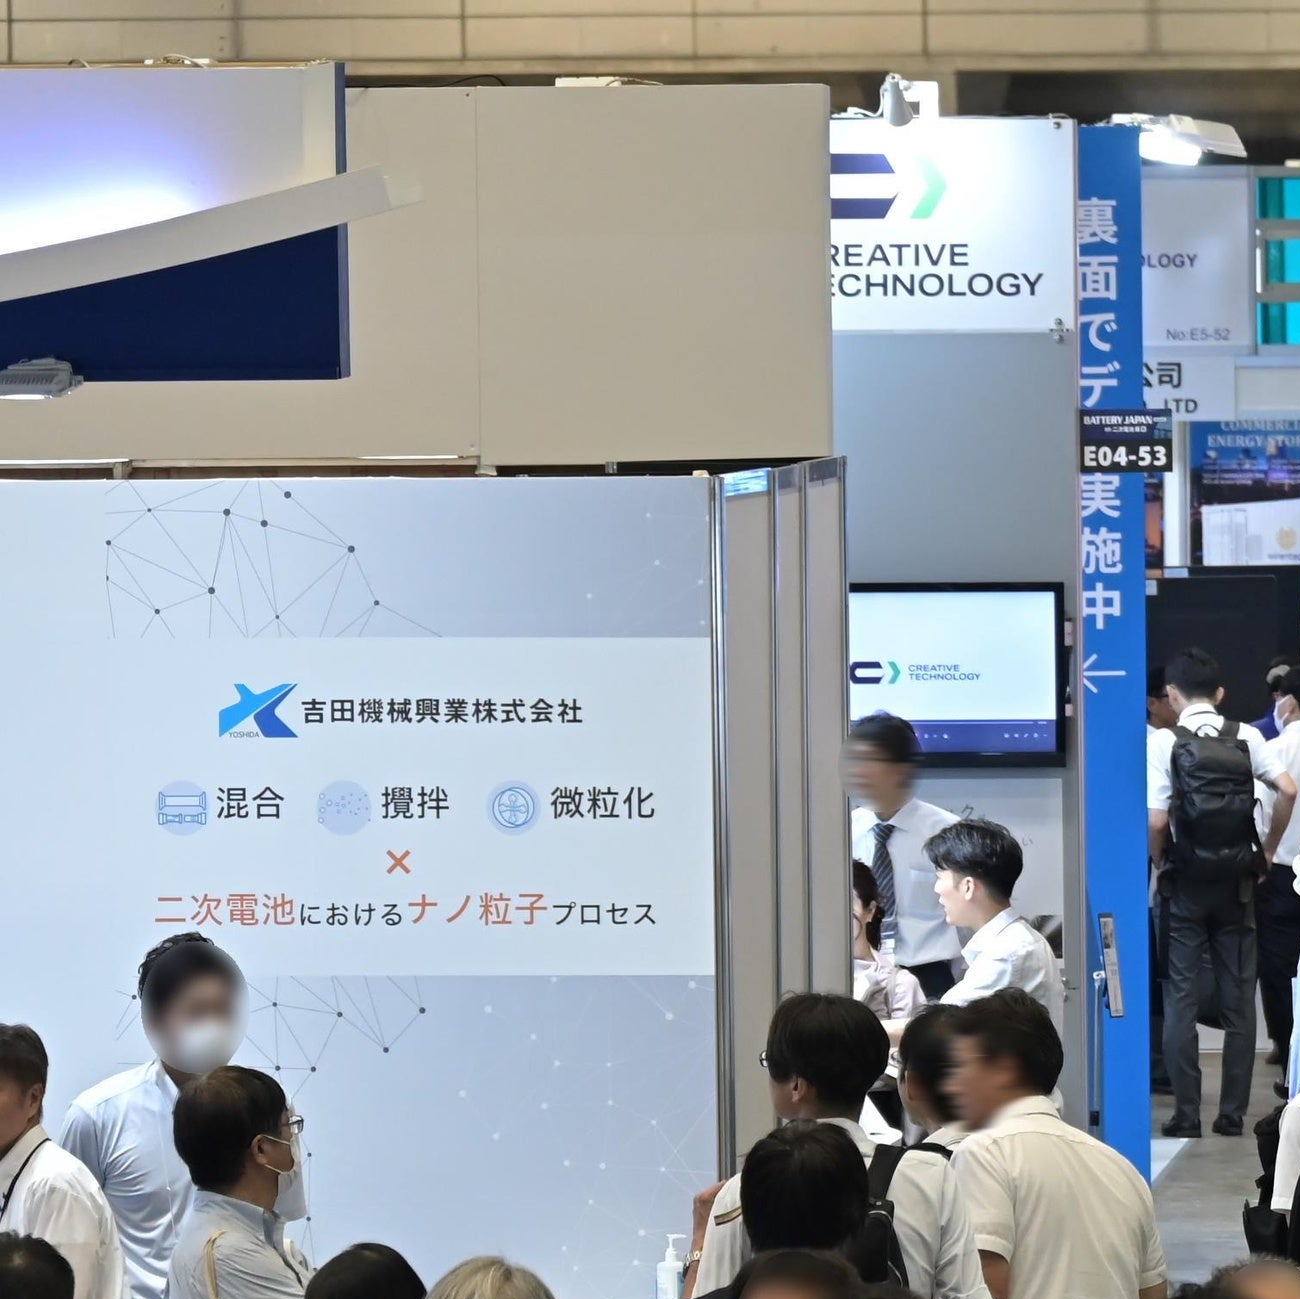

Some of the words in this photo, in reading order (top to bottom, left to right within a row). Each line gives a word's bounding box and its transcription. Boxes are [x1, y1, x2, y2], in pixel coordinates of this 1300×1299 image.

[831, 272, 1043, 297] CHNOLOGY
[1077, 197, 1123, 630] 裏面でデ実施中
[1083, 415, 1122, 425] BATTERY
[1123, 415, 1153, 425] JAPAN
[1083, 445, 1167, 466] E04-53
[908, 664, 960, 672] CREATIVE
[908, 672, 981, 681] TECHNOLOGY
[301, 697, 584, 726] 吉田機械興業株式会社
[216, 785, 286, 821] 混合
[550, 785, 656, 821] 微粒化
[154, 891, 657, 928] 二次電池におけるナノ粒子プロセス
